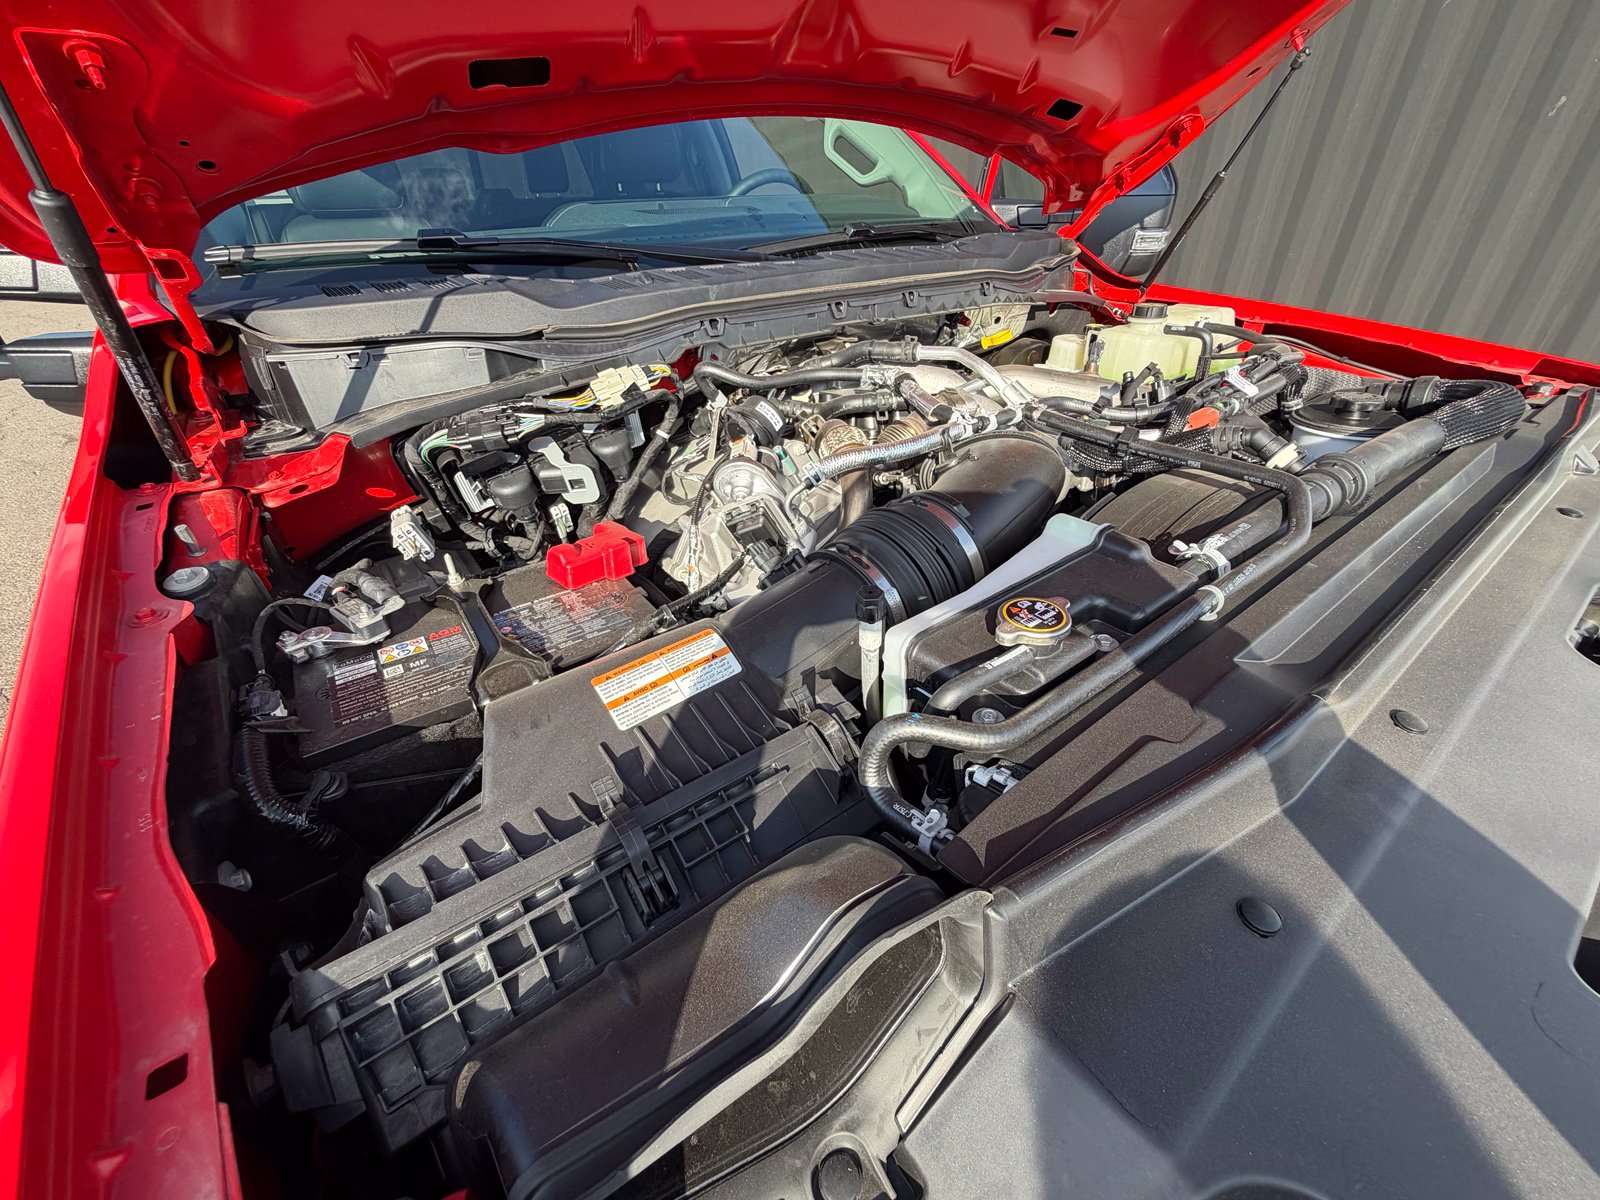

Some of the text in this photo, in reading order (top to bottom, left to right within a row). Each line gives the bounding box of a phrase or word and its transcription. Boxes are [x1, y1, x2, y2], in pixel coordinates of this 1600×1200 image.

[429, 625, 462, 641] AGM
[334, 654, 372, 670] FoMoCo
[632, 686, 648, 697] AVISO
